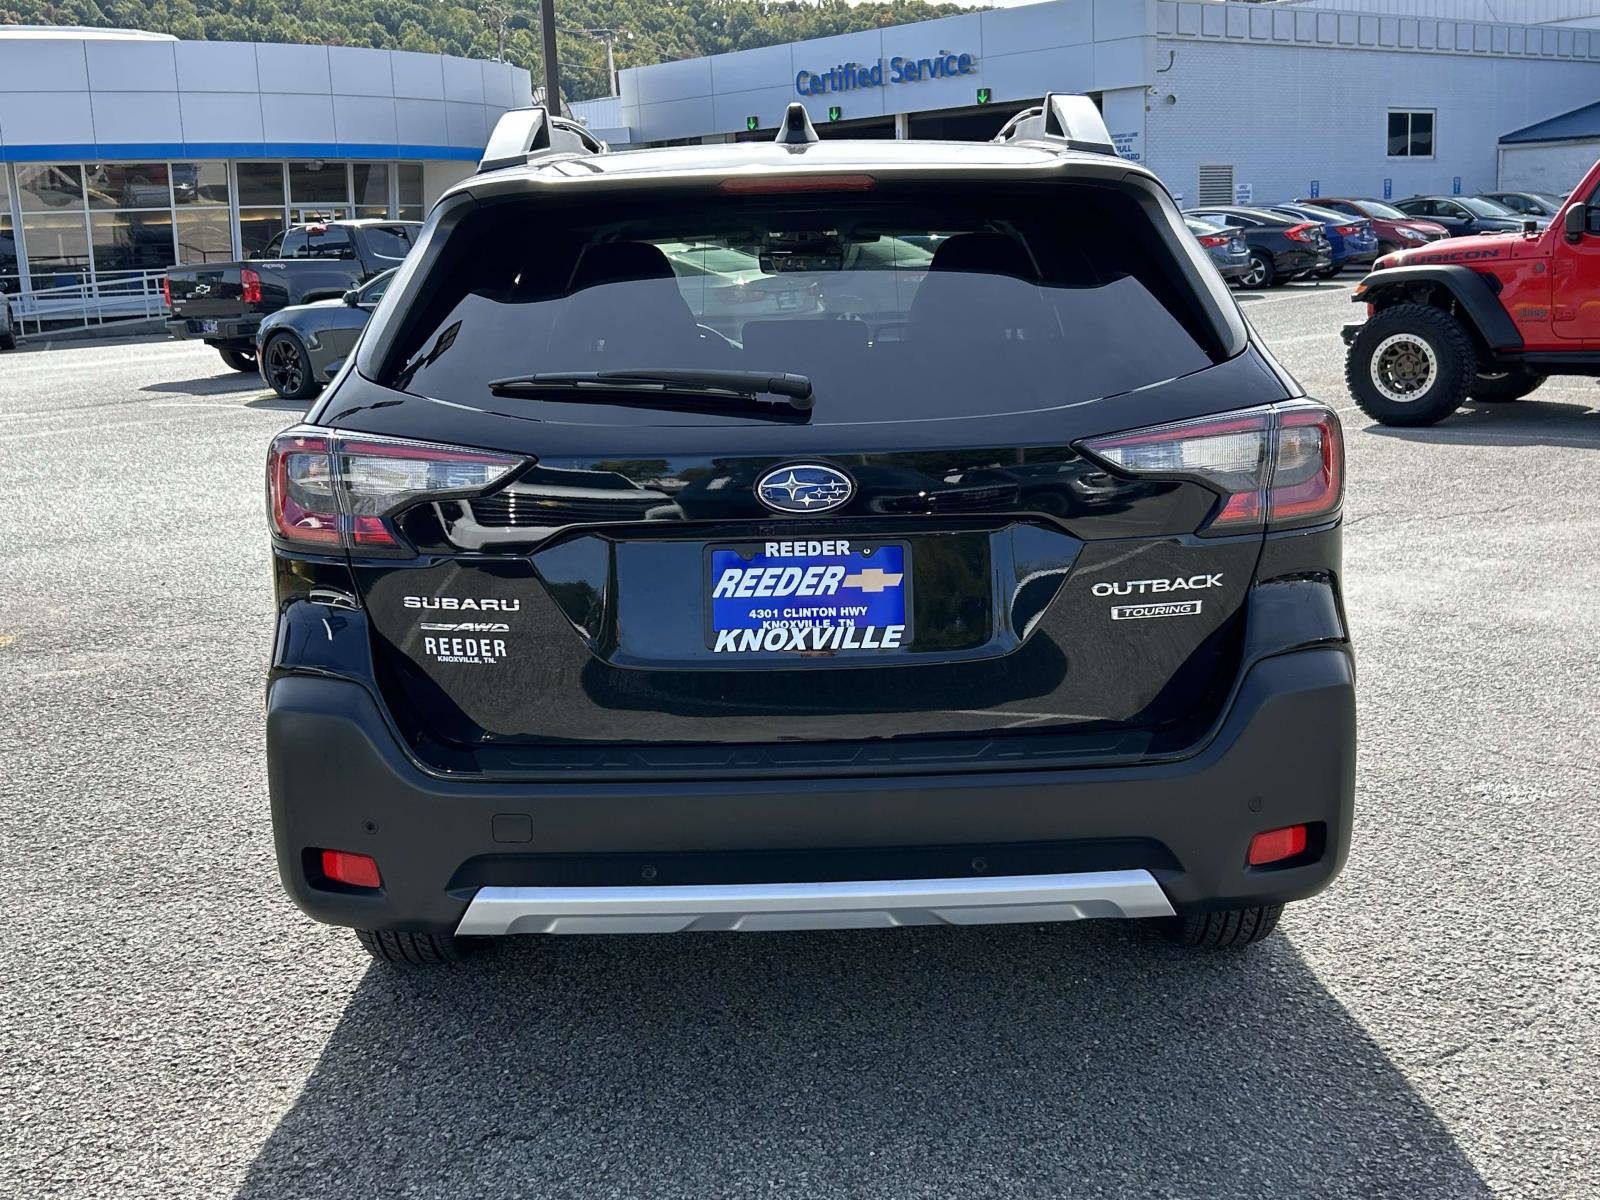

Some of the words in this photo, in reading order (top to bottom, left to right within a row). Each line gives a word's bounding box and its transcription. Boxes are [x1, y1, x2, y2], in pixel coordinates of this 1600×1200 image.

[796, 58, 883, 96] Certified
[890, 50, 973, 83] Service
[765, 540, 851, 557] REEDER
[712, 565, 846, 598] REEDER
[1091, 573, 1223, 597] OUTBACK
[403, 596, 520, 611] SUBARU
[1123, 604, 1192, 617] TOURING
[749, 608, 779, 619] 4301
[783, 607, 837, 618] CLINTON
[840, 606, 868, 617] HWY
[452, 622, 510, 632] AWD
[838, 618, 855, 628] TN
[713, 624, 906, 653] KNOXVILLE
[424, 637, 507, 657] REEDER
[437, 655, 482, 664] KNOXVILLE,
